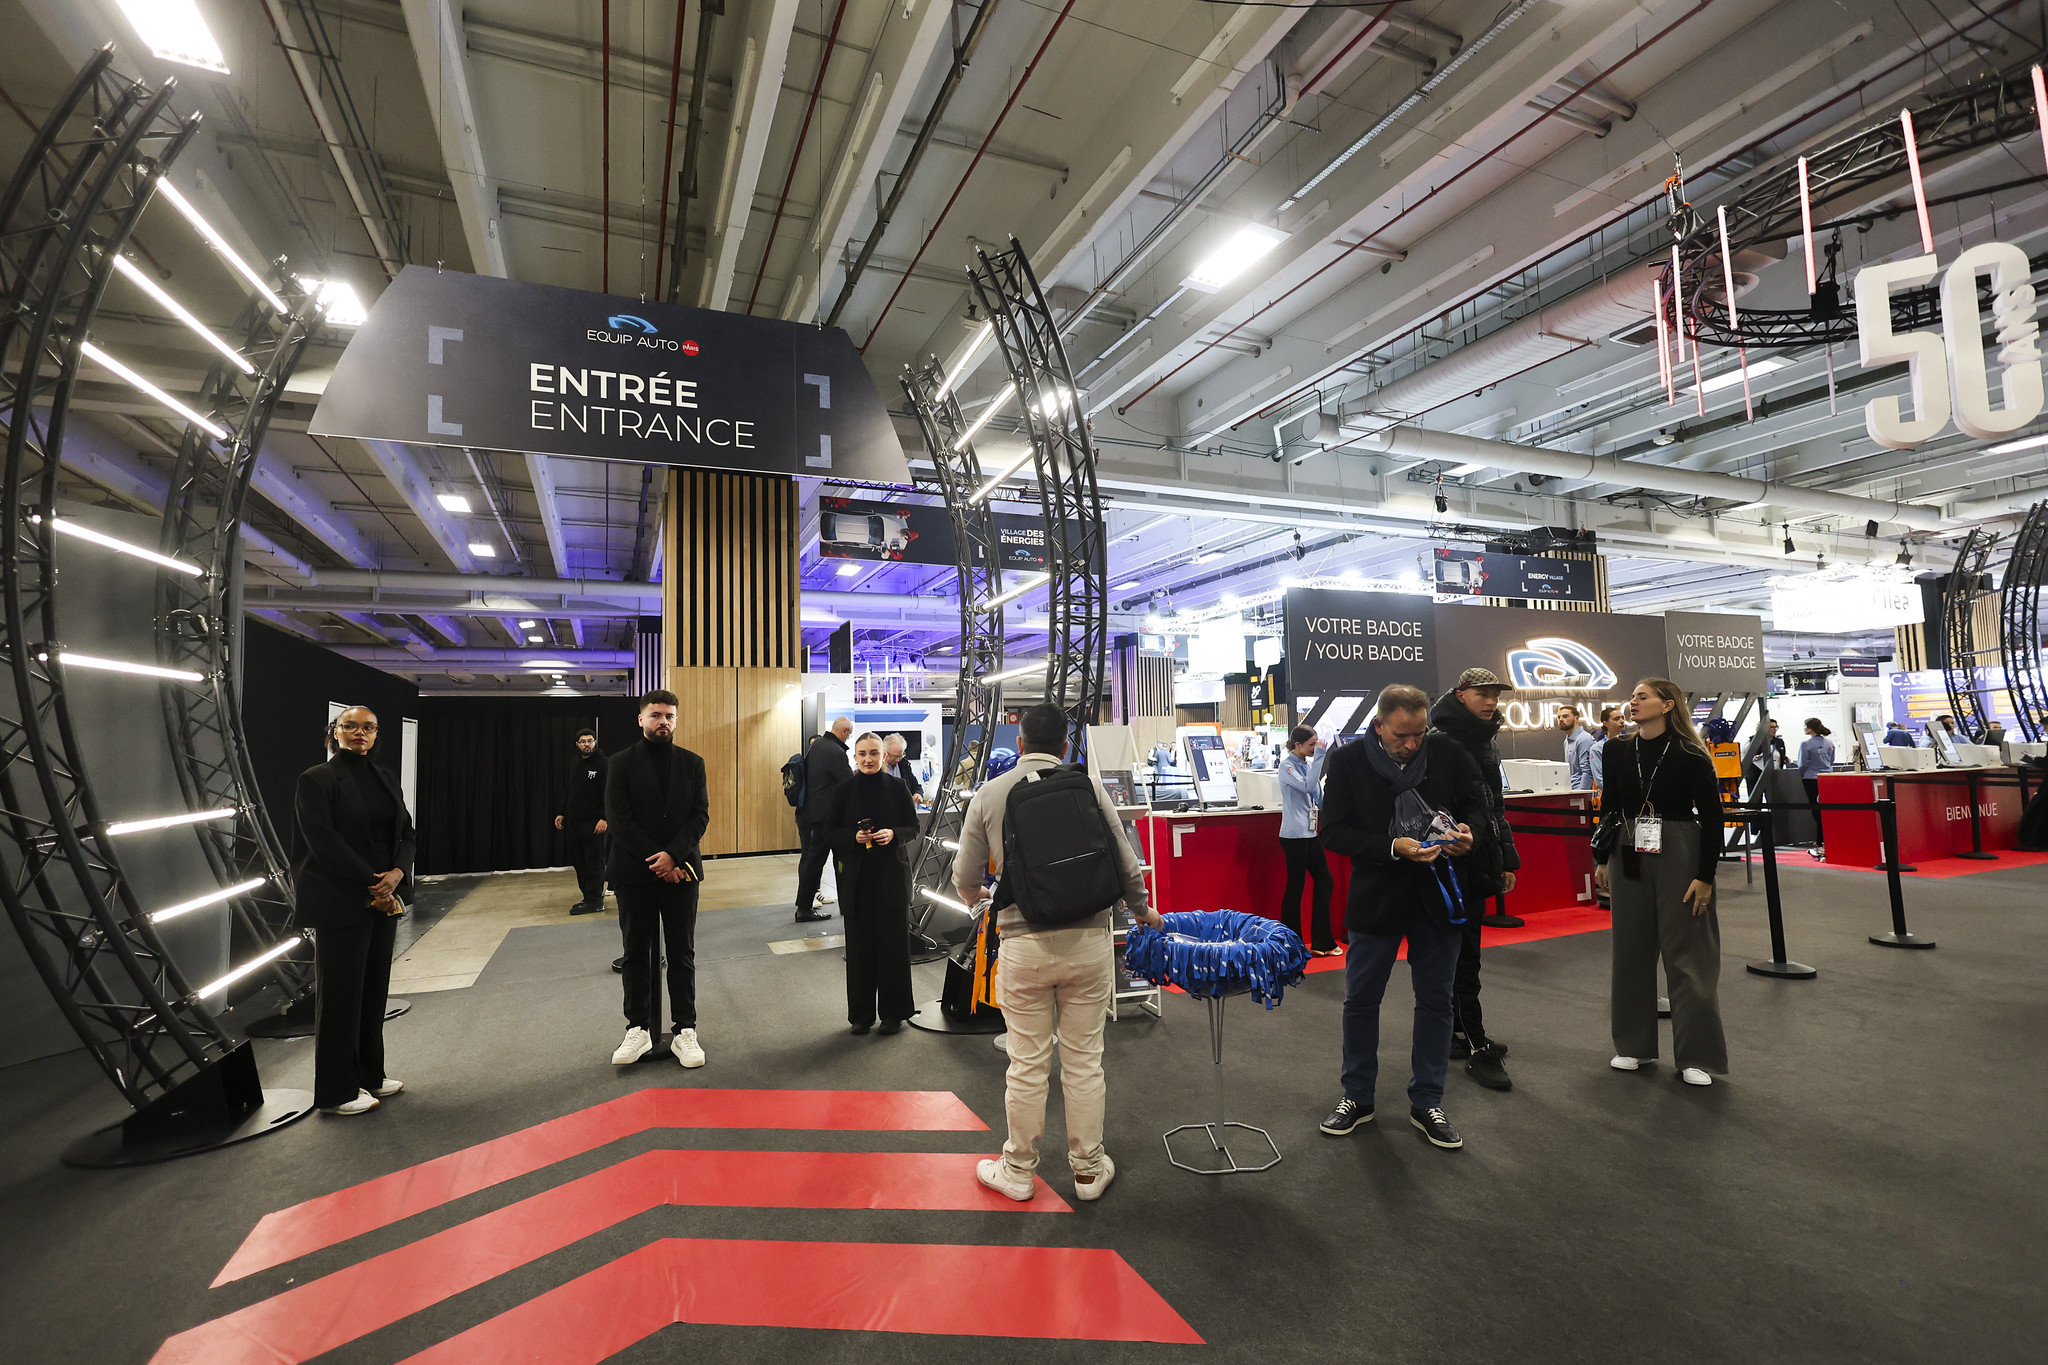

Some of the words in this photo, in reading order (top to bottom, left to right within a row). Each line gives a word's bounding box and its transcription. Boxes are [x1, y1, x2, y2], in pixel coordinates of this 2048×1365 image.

[586, 329, 633, 345] EQUIP
[636, 336, 679, 352] AUTO
[682, 342, 700, 353] PARIS
[1854, 242, 2045, 450] 50
[530, 361, 699, 409] ENTRÉE
[531, 400, 756, 449] ENTRANCE
[1000, 534, 1045, 546] ÉNERGIES
[1026, 529, 1045, 538] DES
[1304, 616, 1362, 635] VOTRE
[1366, 620, 1423, 638] BADGE
[1676, 633, 1715, 648] VOTRE
[1716, 635, 1755, 649] BADGE
[1314, 643, 1364, 660] YOUR
[1368, 645, 1424, 662] BADGE
[1684, 655, 1717, 668] YOUR
[1718, 655, 1757, 669] BADGE
